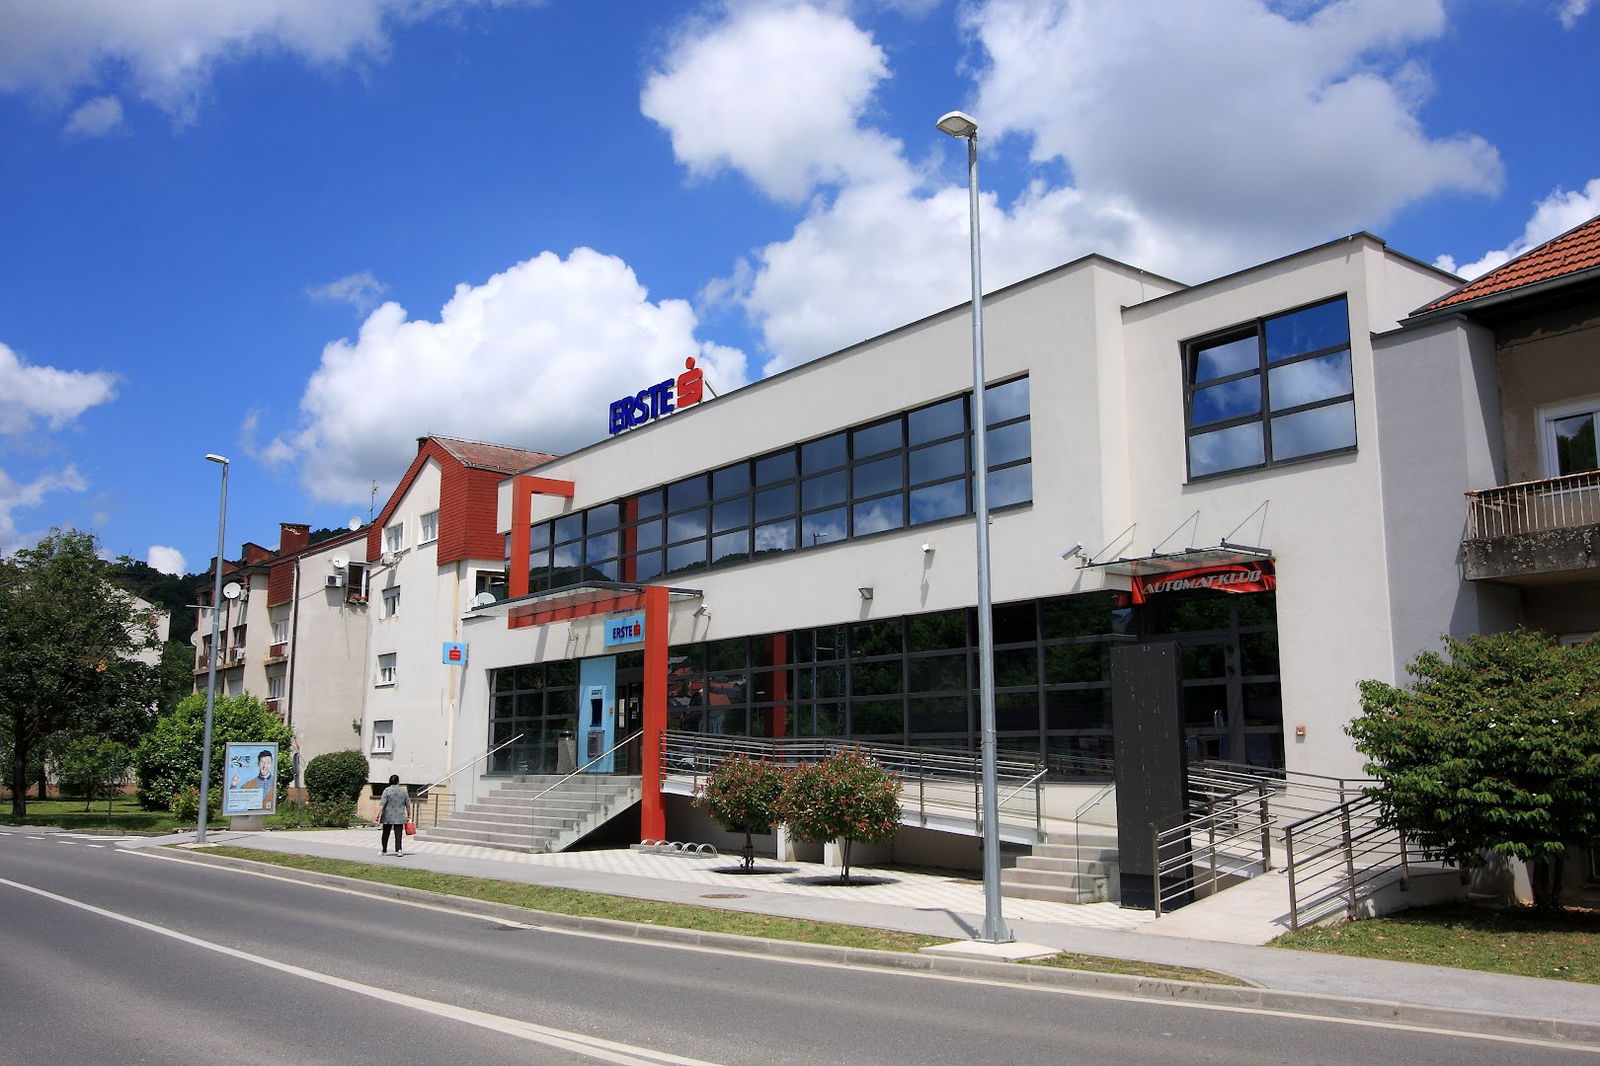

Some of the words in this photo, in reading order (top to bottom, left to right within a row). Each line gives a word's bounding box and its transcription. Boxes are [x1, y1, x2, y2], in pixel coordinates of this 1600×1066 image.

[609, 378, 675, 434] ERSTE
[1141, 575, 1217, 594] AUTOMAT
[1218, 570, 1262, 585] KLUB
[612, 625, 633, 640] ERSTE
